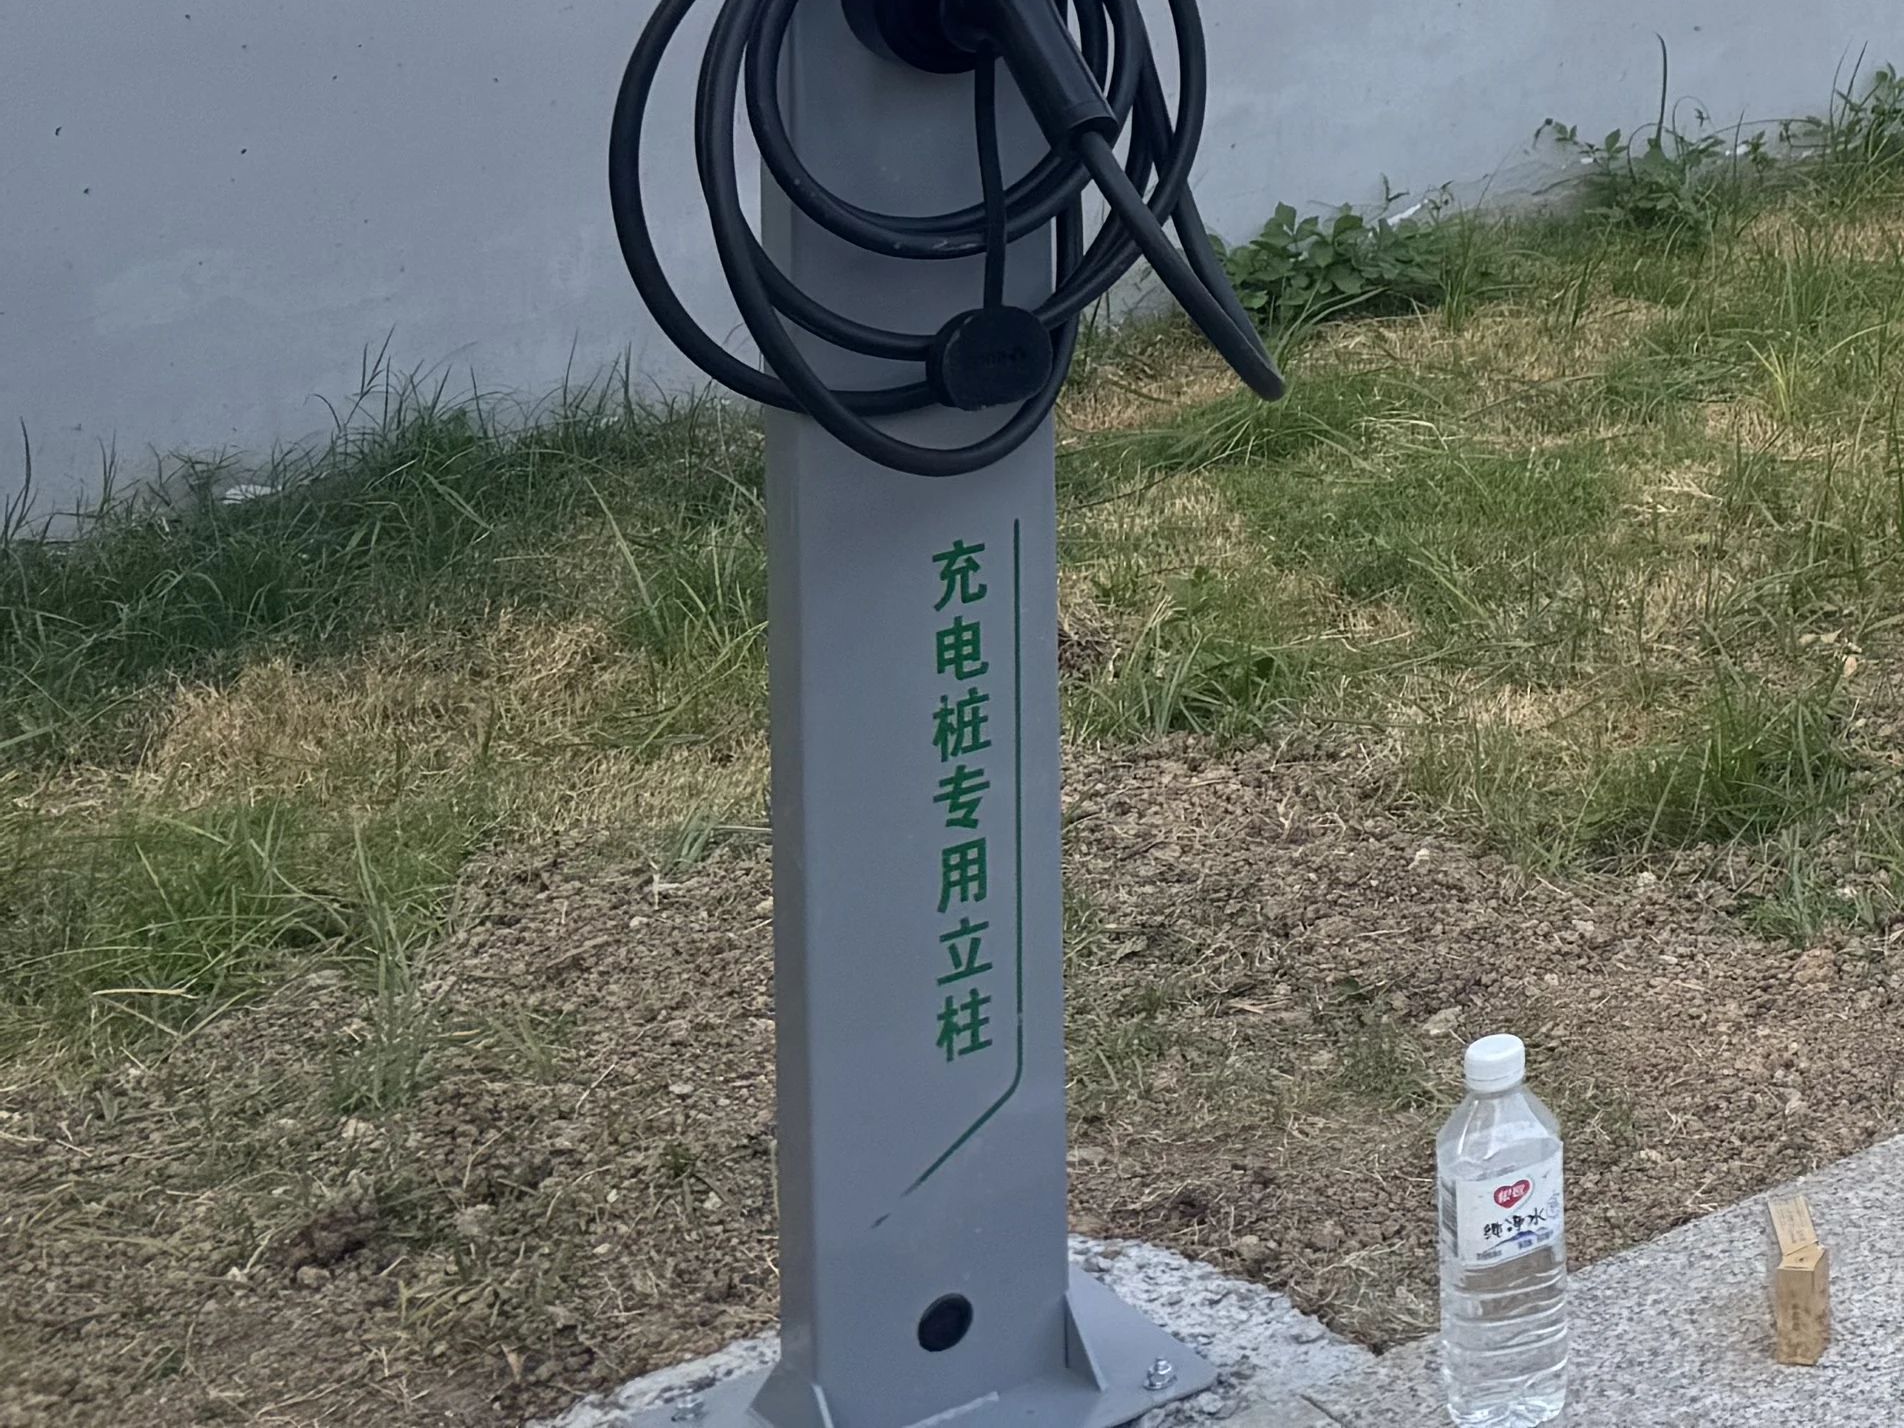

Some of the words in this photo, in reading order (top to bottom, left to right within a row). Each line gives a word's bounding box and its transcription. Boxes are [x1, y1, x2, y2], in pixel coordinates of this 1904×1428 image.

[931, 538, 993, 1064] 充电桩专用立柱
